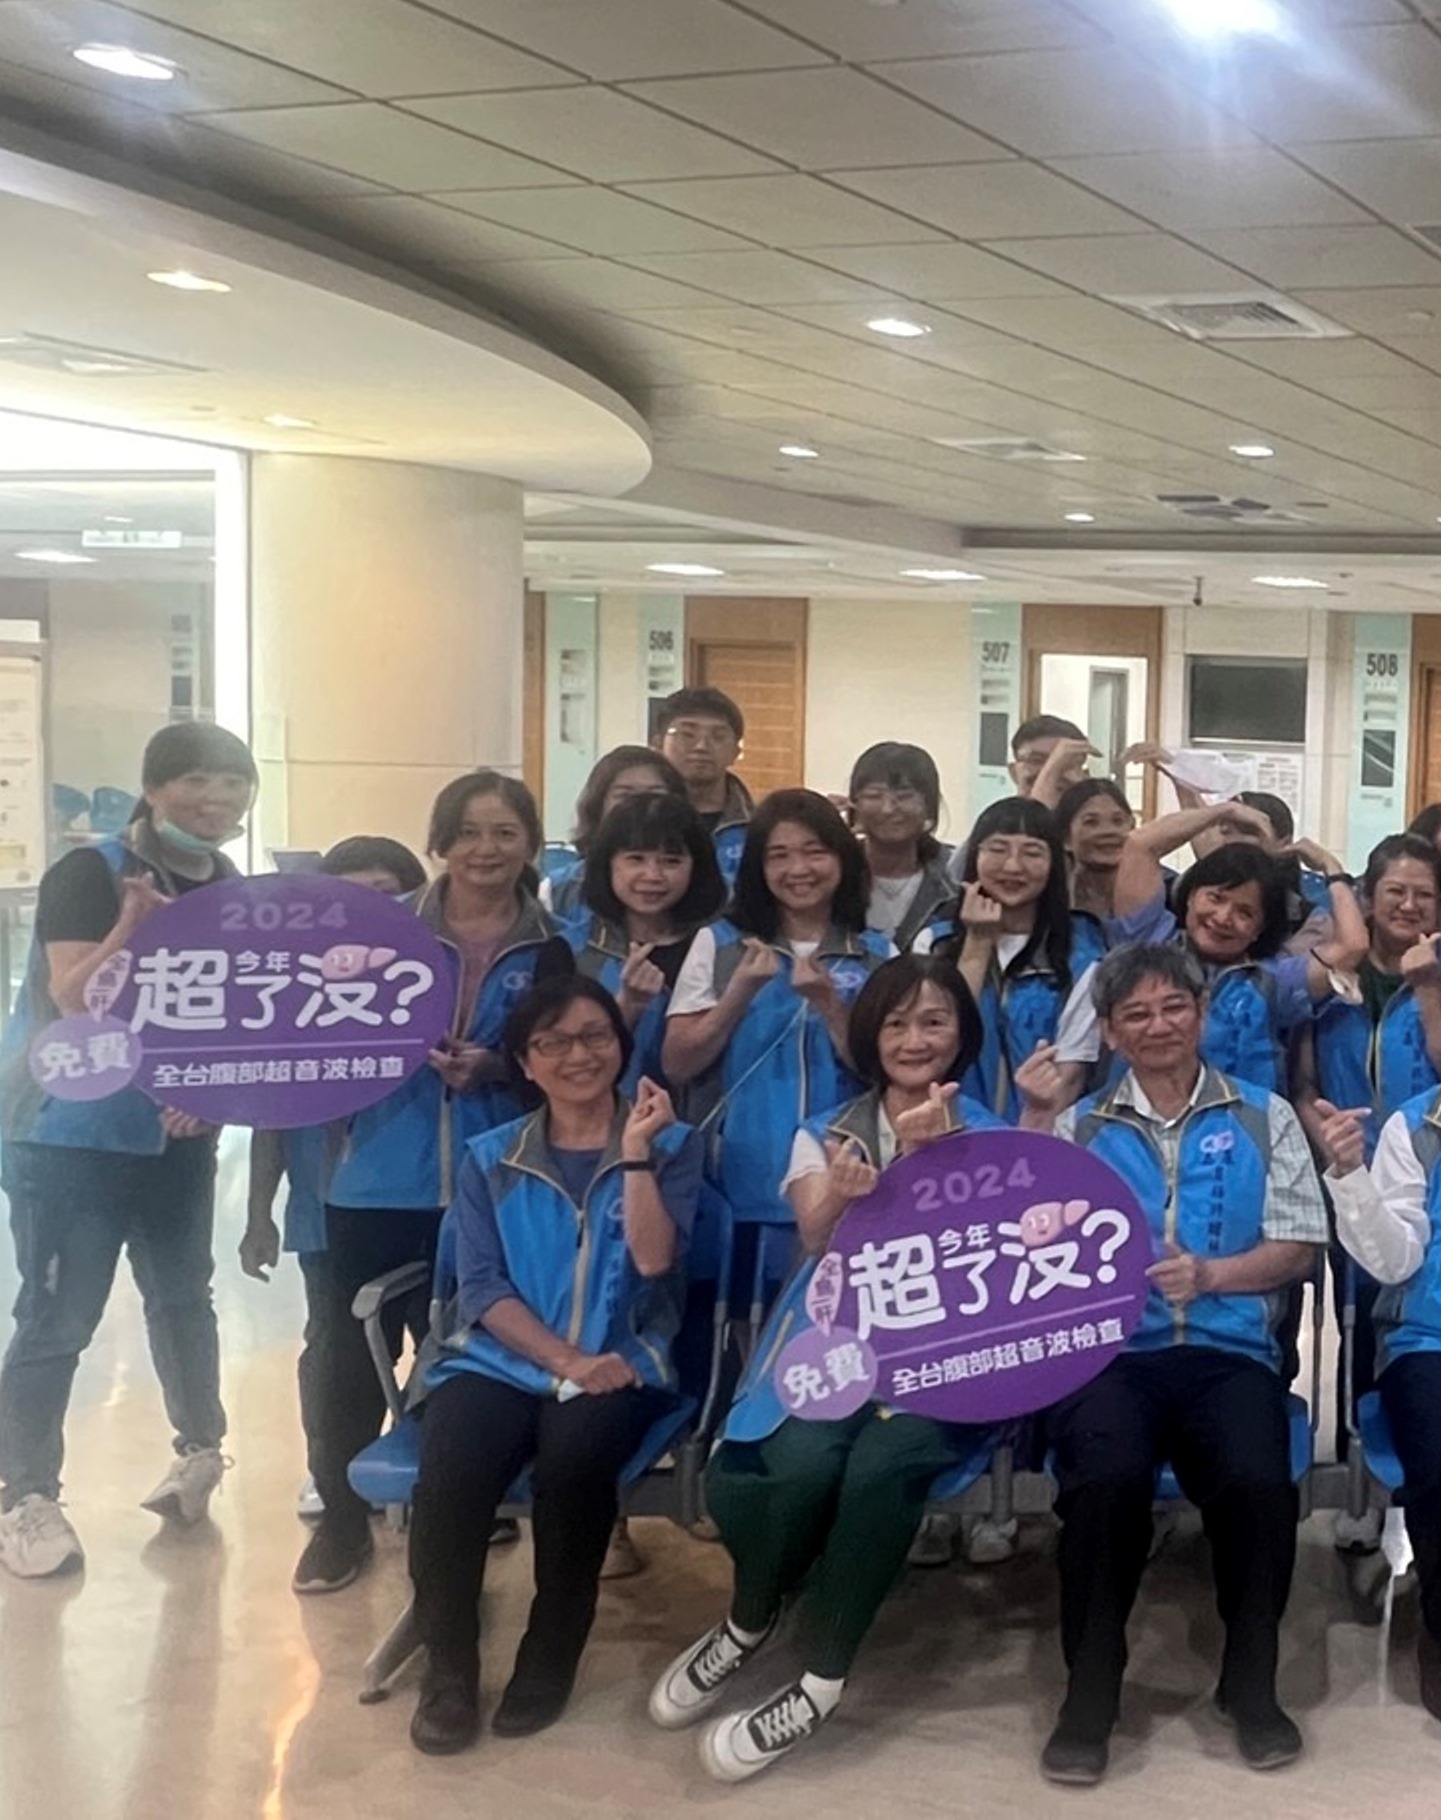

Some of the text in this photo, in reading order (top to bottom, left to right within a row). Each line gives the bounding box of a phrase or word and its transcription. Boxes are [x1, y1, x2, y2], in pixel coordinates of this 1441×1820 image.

[981, 641, 1010, 663] 507
[1365, 652, 1399, 677] 508
[220, 902, 348, 932] 2024
[39, 1031, 132, 1082] 免費
[153, 1056, 405, 1089] 全台腹部超音波檢查
[911, 1157, 1036, 1212] 2024
[783, 1341, 871, 1409] 免費
[892, 1317, 1125, 1397] 全台腹部超音波檢查
